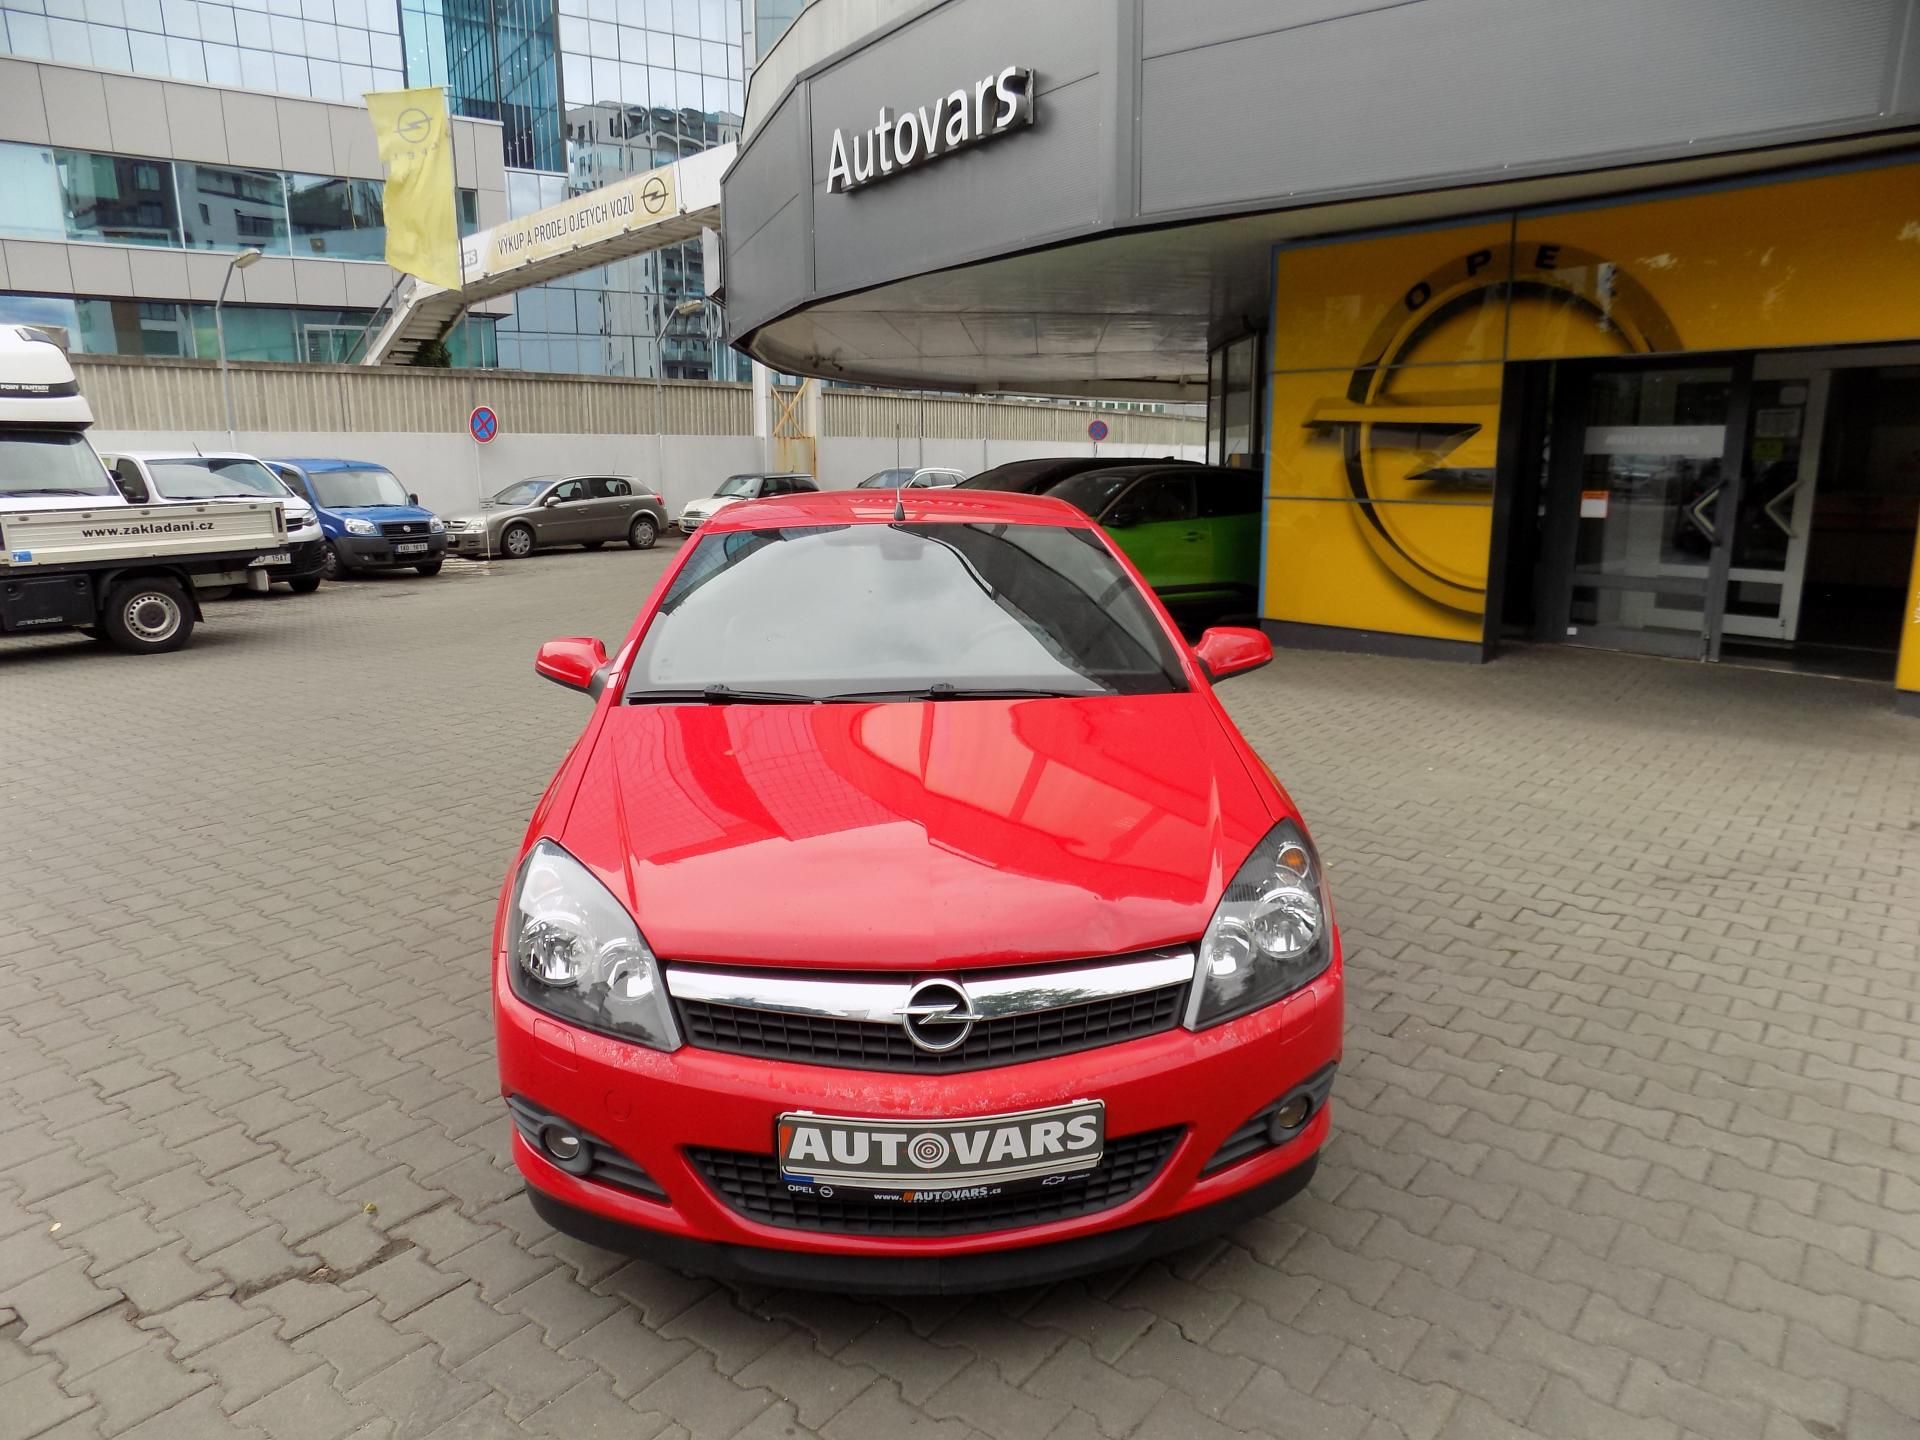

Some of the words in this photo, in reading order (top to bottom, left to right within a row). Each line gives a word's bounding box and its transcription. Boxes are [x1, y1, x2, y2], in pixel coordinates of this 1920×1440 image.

[827, 66, 1019, 193] Autovars
[498, 232, 524, 255] VÝKUP
[527, 230, 533, 246] A
[534, 218, 567, 244] PRODEJ
[570, 203, 607, 232] OJETÝCH
[82, 521, 215, 537] www.zakladani.cz
[788, 1115, 1097, 1169] AUTOVARS
[787, 1185, 815, 1194] OPEL
